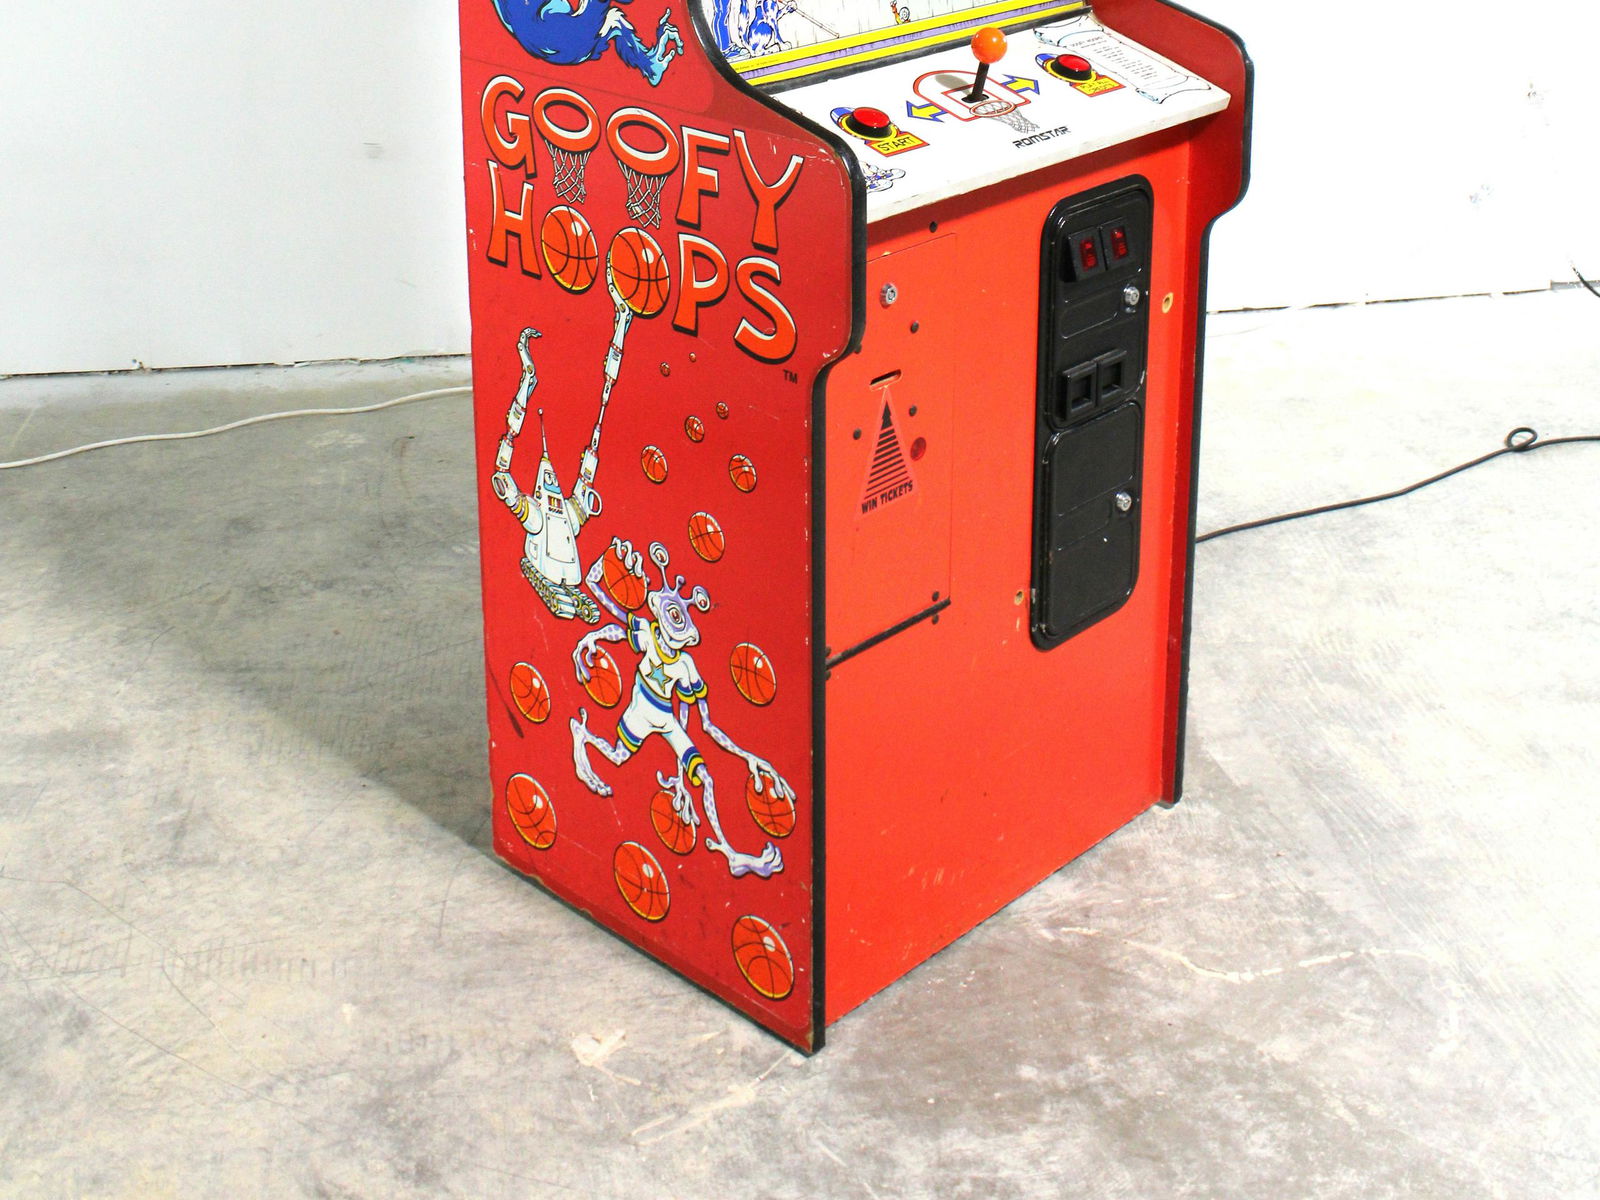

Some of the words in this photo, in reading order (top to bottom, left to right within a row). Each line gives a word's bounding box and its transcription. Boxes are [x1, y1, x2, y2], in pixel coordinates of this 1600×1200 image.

[877, 136, 916, 151] START
[1012, 126, 1071, 148] ROMSTAR
[481, 74, 804, 254] GOOFY
[487, 159, 798, 364] HOOPS
[783, 370, 798, 384] TM
[862, 497, 877, 514] WIN
[880, 480, 913, 504] TICKETS
